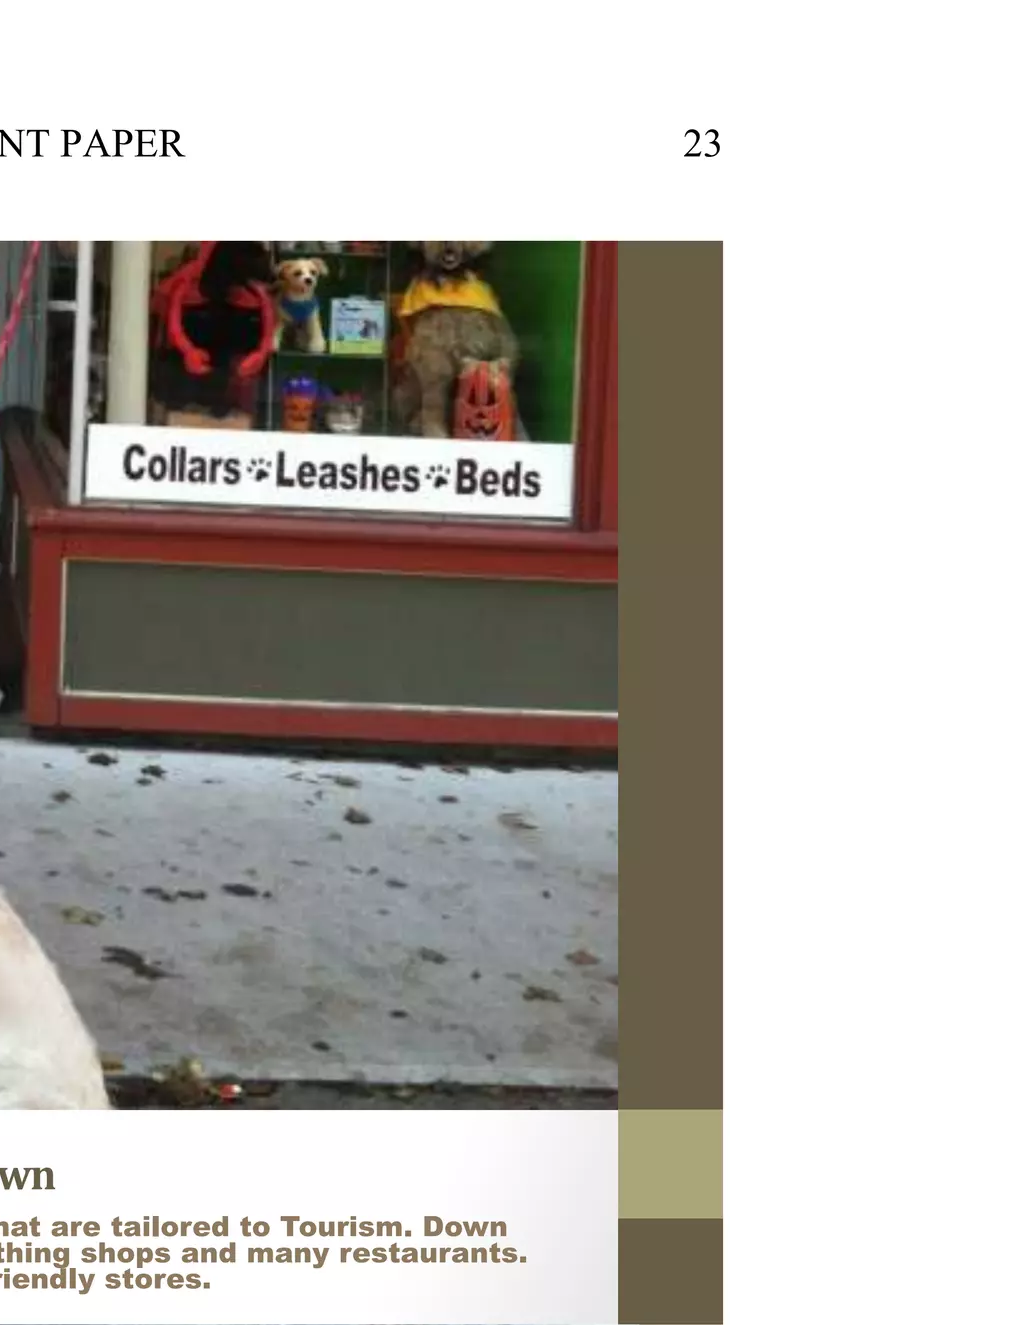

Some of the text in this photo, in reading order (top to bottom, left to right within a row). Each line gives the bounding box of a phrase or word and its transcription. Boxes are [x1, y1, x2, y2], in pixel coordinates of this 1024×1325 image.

[61, 129, 185, 157] PAPER
[684, 129, 720, 157] 23
[123, 444, 541, 498] Collars Leashes Beds
